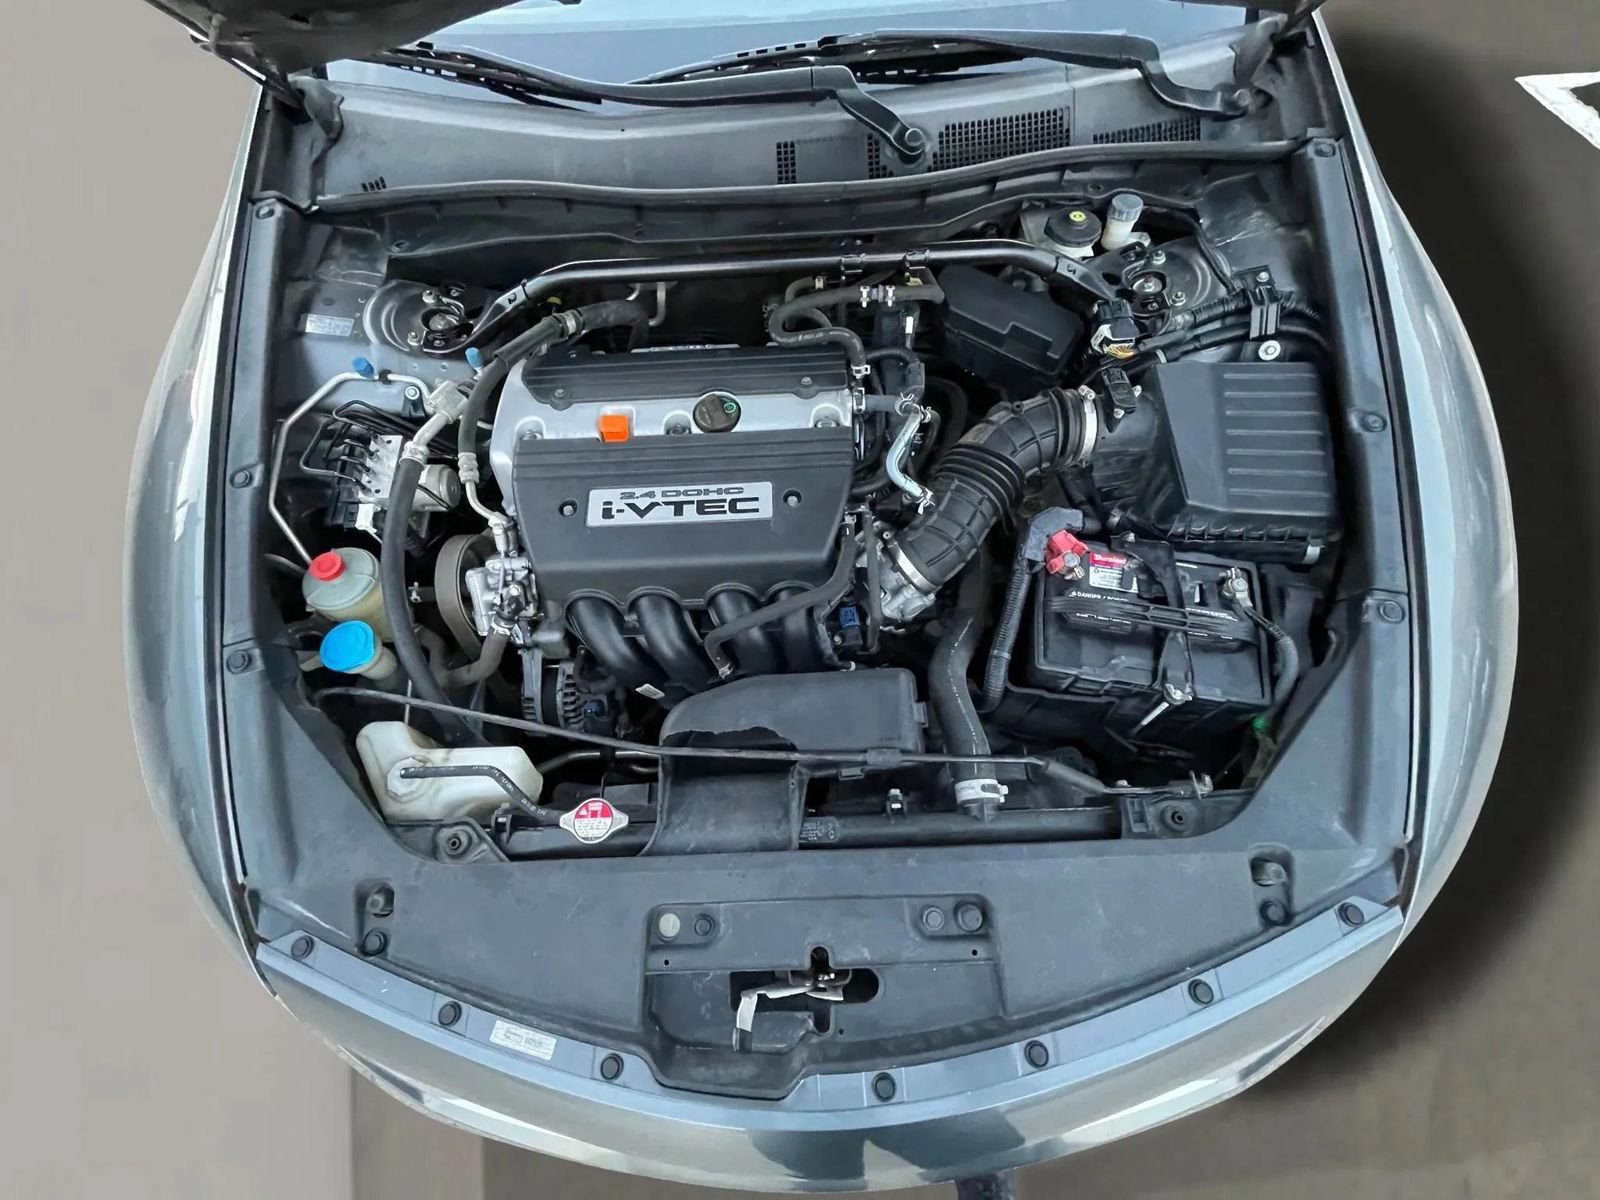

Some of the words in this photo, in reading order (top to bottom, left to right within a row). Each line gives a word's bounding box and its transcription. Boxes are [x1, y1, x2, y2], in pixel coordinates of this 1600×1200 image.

[620, 490, 656, 500] 2.4
[661, 486, 744, 498] DOHC
[601, 497, 760, 520] i-VTEC
